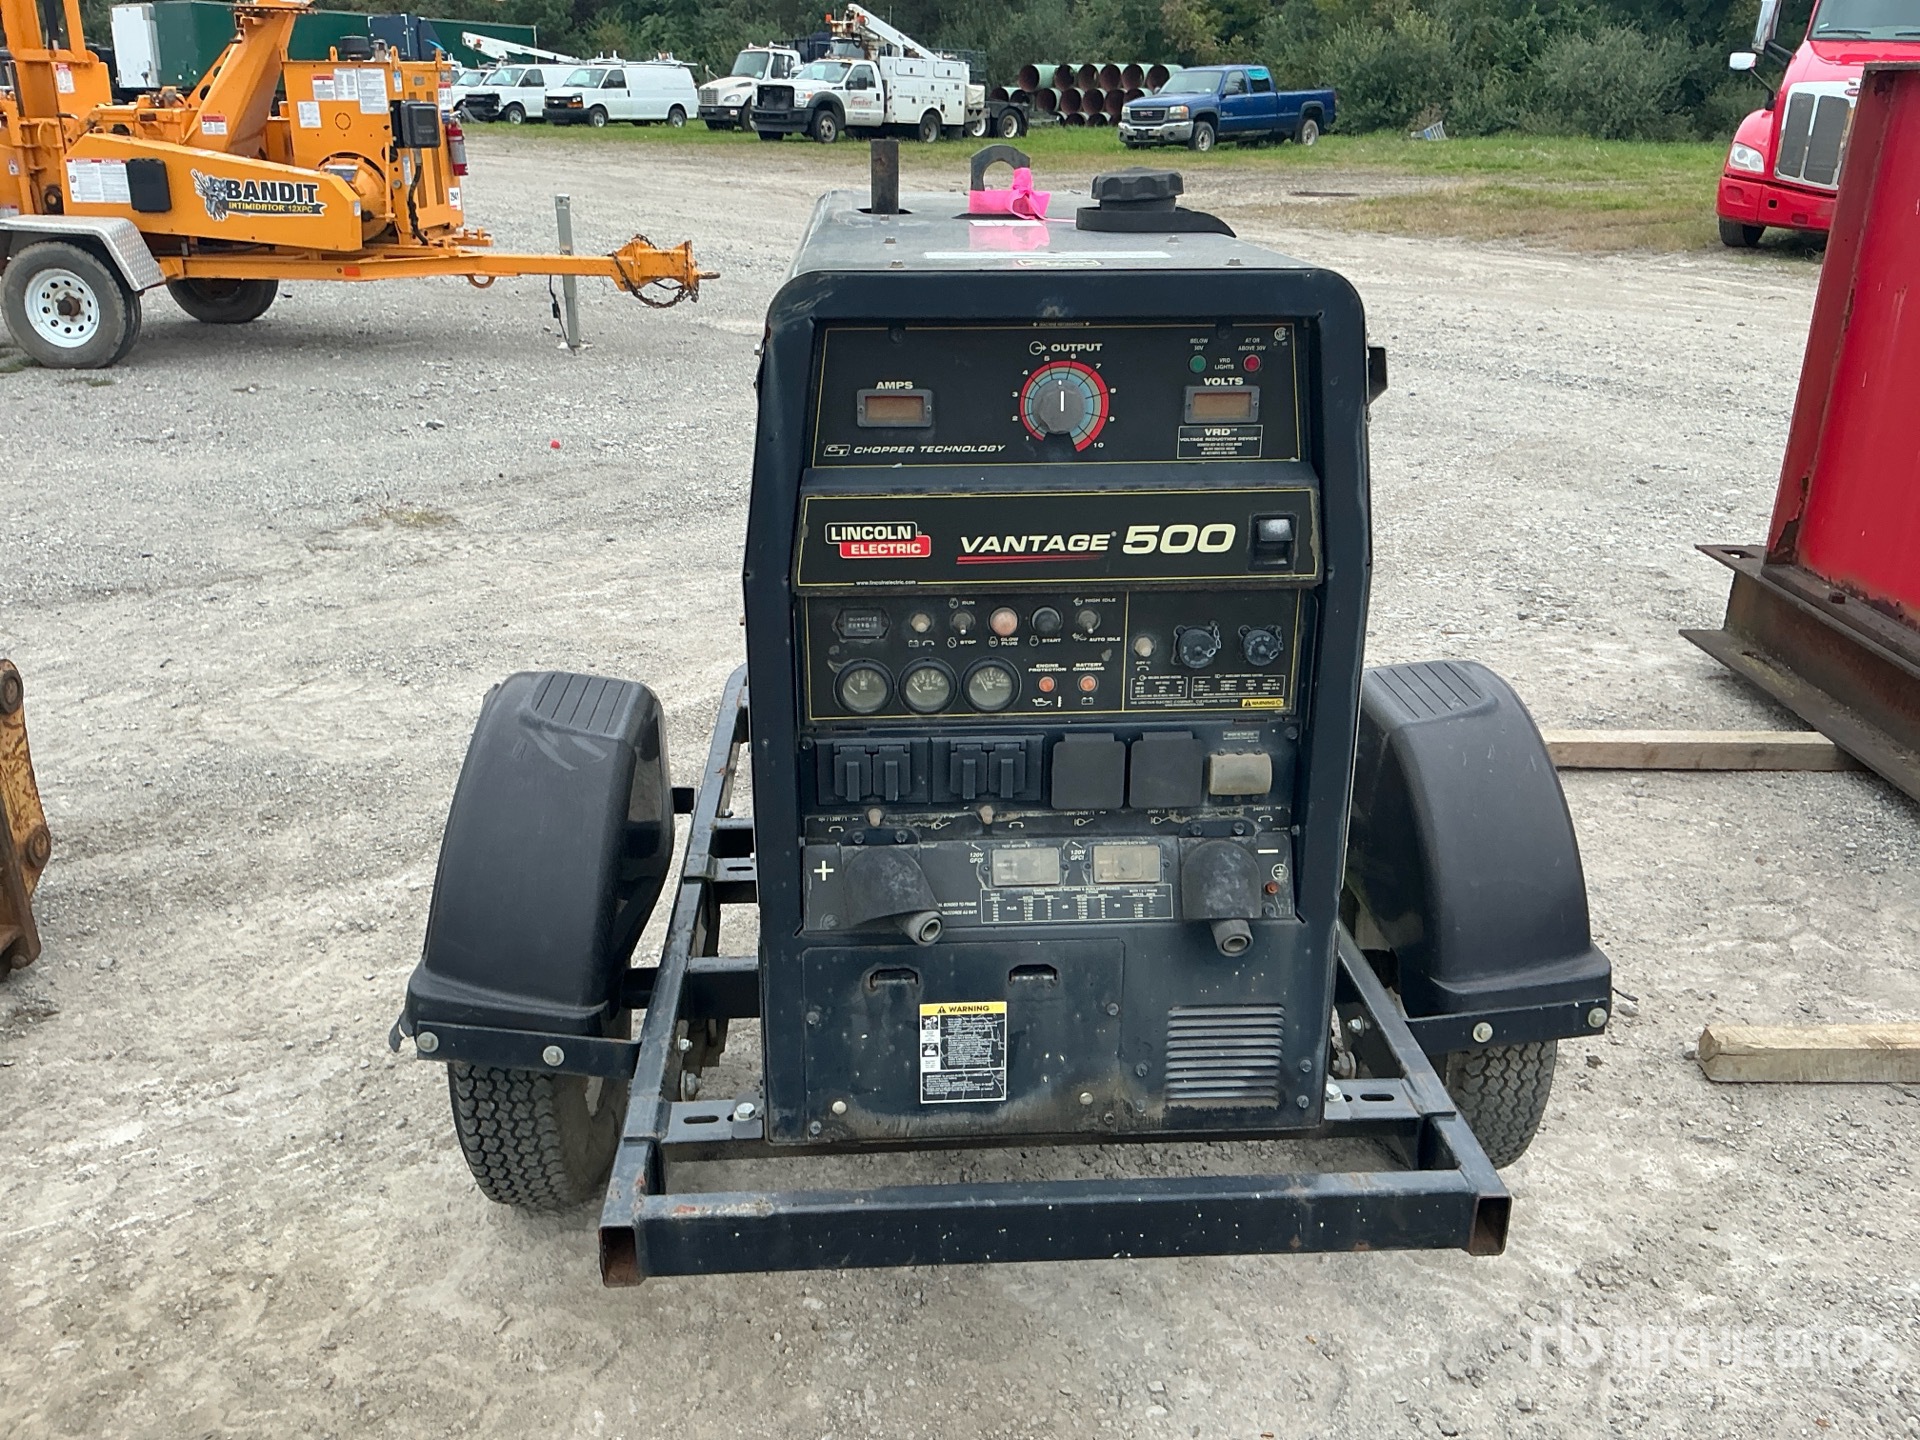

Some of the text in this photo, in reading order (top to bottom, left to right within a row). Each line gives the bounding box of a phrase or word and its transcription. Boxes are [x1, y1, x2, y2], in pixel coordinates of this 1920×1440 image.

[225, 180, 318, 204] BANDIT
[228, 201, 313, 213] INTIMIDATOR 12XPC
[1050, 343, 1103, 352] OUTPUT
[876, 381, 914, 390] AMPS
[1203, 377, 1244, 386] VOLTS
[1204, 428, 1231, 436] VRD
[853, 446, 915, 454] CHOPPER
[920, 445, 1006, 453] TECHNOLOGY
[831, 525, 912, 541] LINCOLN
[960, 533, 1111, 553] VANTAGE
[1122, 523, 1236, 554] 500
[850, 543, 922, 555] ELECTRIC
[949, 1005, 990, 1013] WARNING
